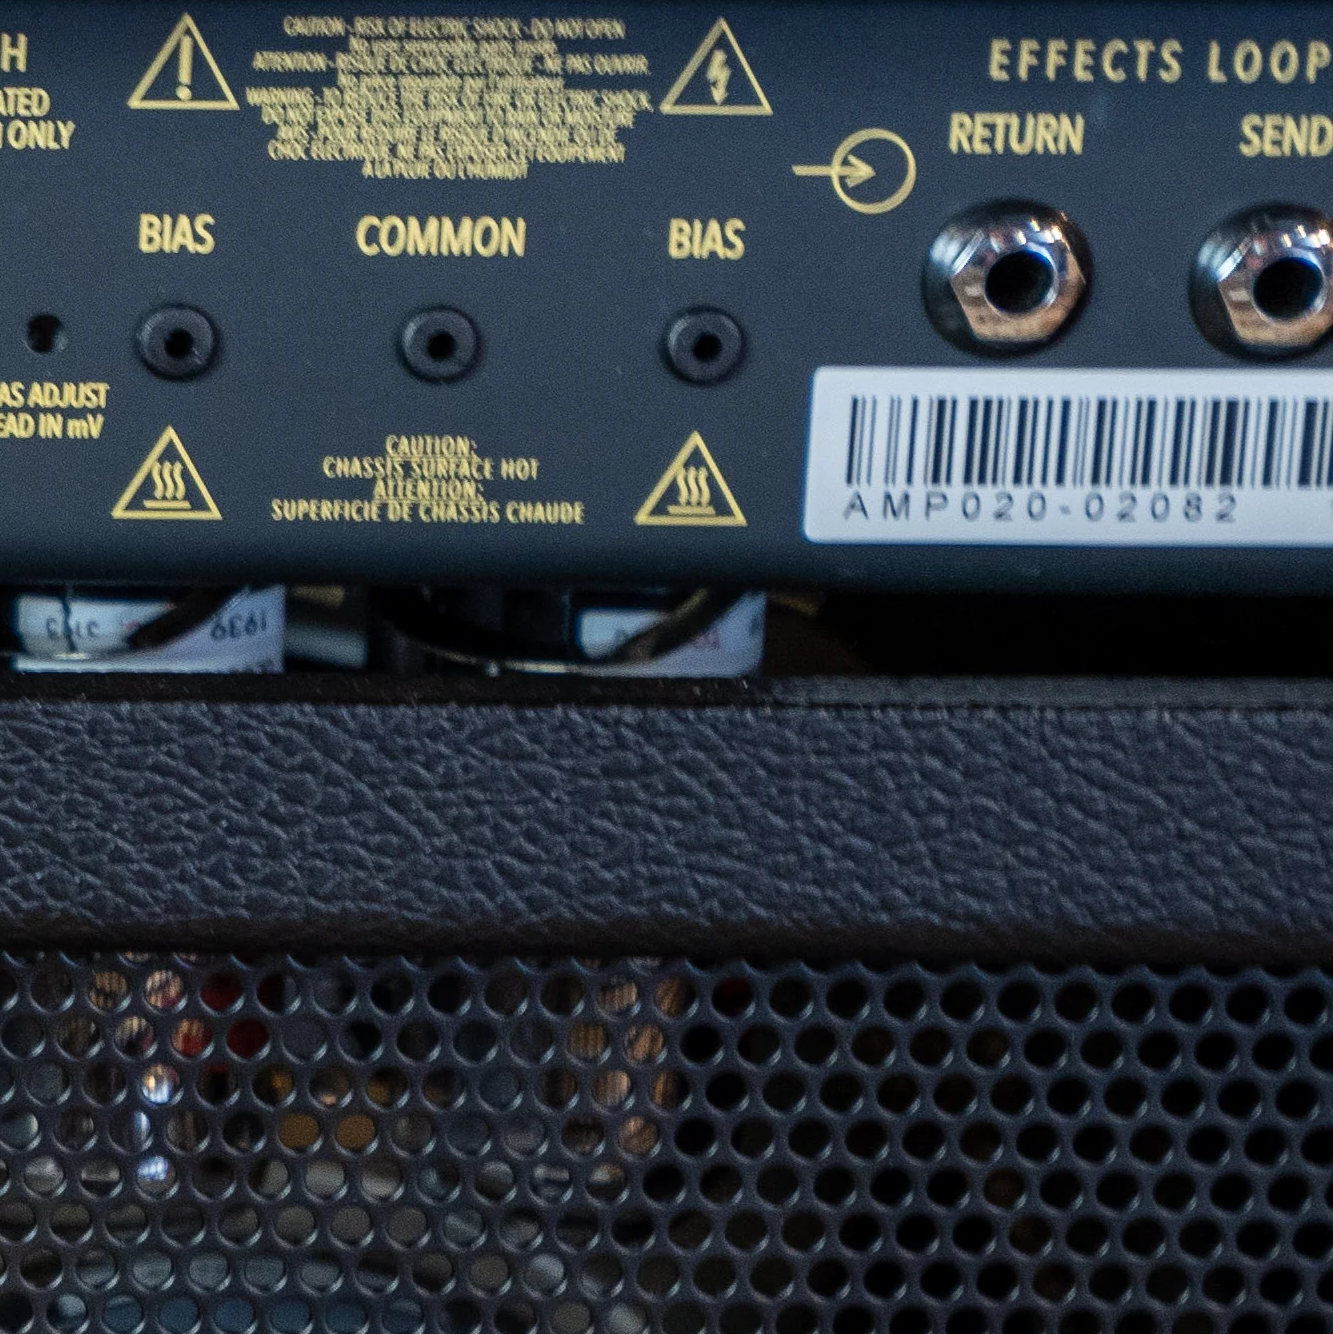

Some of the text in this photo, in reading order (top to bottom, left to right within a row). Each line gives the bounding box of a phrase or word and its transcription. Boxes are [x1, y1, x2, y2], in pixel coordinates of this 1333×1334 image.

[989, 38, 1331, 84] EFFECTS LOOP
[6, 118, 75, 150] ONLY
[949, 112, 1085, 155] RETURN
[1239, 114, 1333, 157] SEND
[138, 212, 216, 254] BIAS
[355, 214, 527, 257] COMMON
[668, 217, 745, 260] BIAS
[26, 381, 109, 409] ADJUST
[36, 412, 66, 438] IN
[66, 413, 105, 438] mV
[321, 456, 540, 481] CHASSIS SURFACE HOT
[270, 497, 585, 525] SUPERFICIE DE CHASSIS CHAUDE
[843, 492, 1239, 522] AMP020-02082
